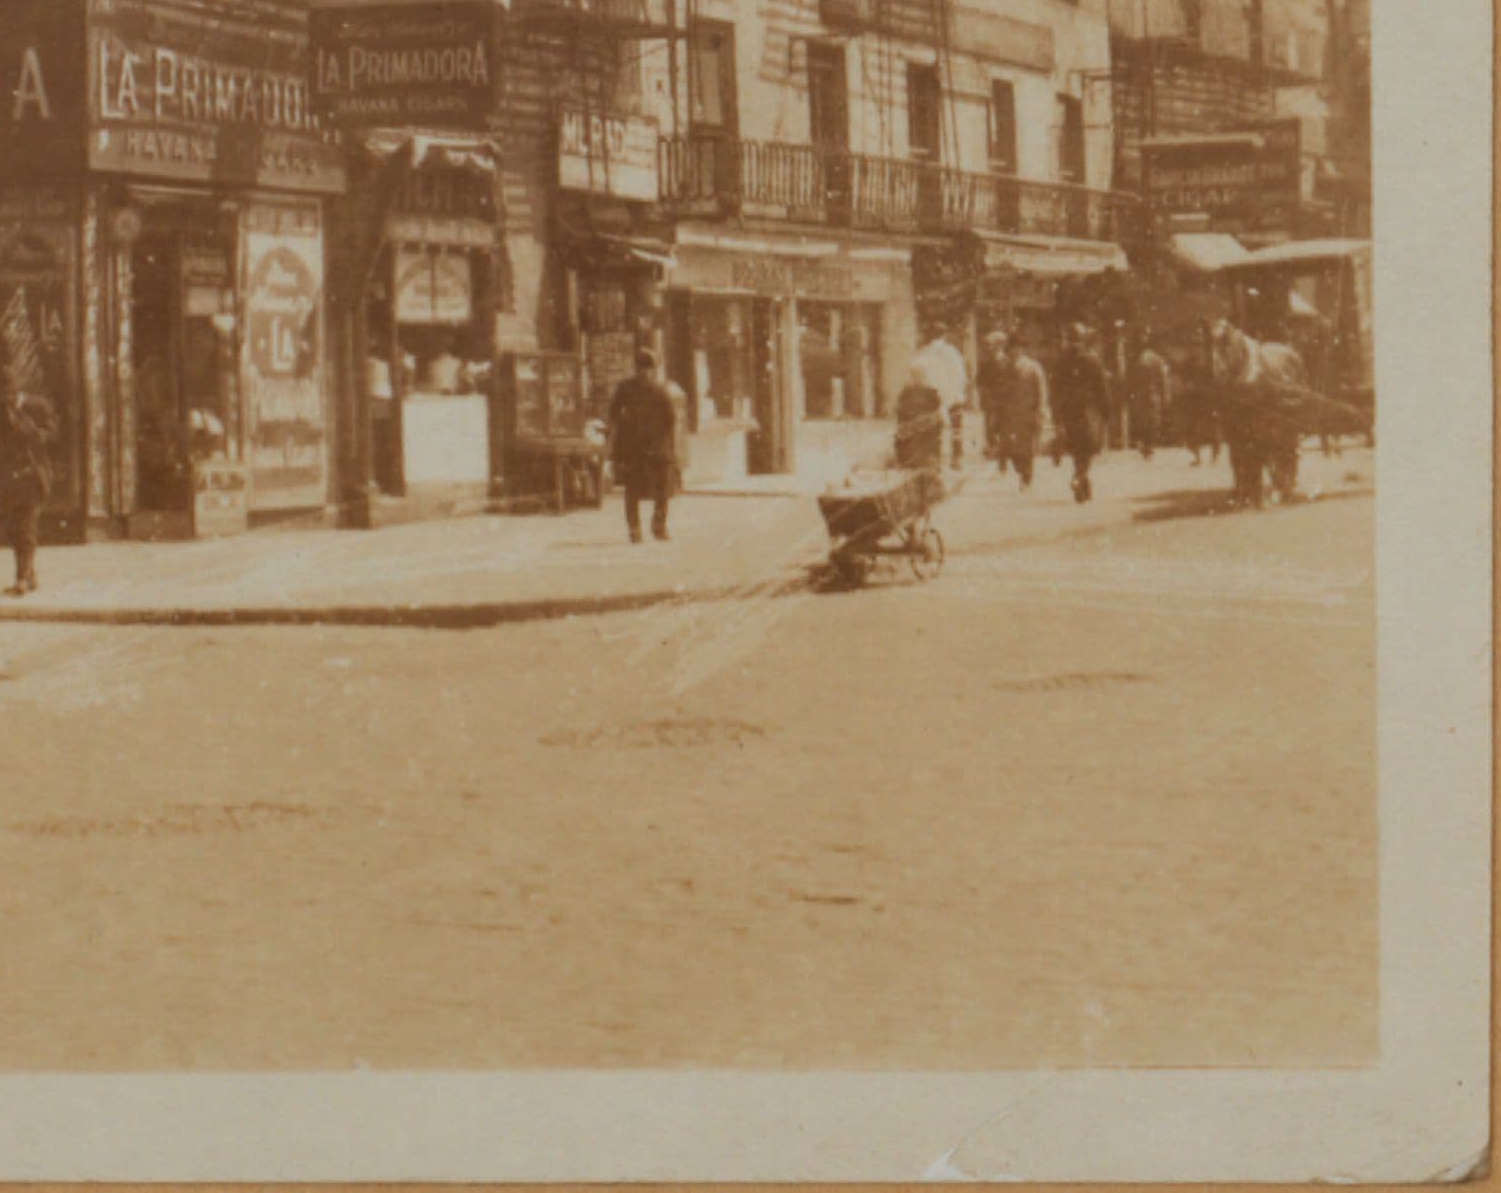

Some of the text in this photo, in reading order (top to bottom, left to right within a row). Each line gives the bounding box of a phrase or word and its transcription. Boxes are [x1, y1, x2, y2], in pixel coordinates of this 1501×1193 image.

[100, 37, 139, 119] LA
[317, 38, 490, 94] LA PRIMADORA
[125, 127, 217, 163] HAVANA
